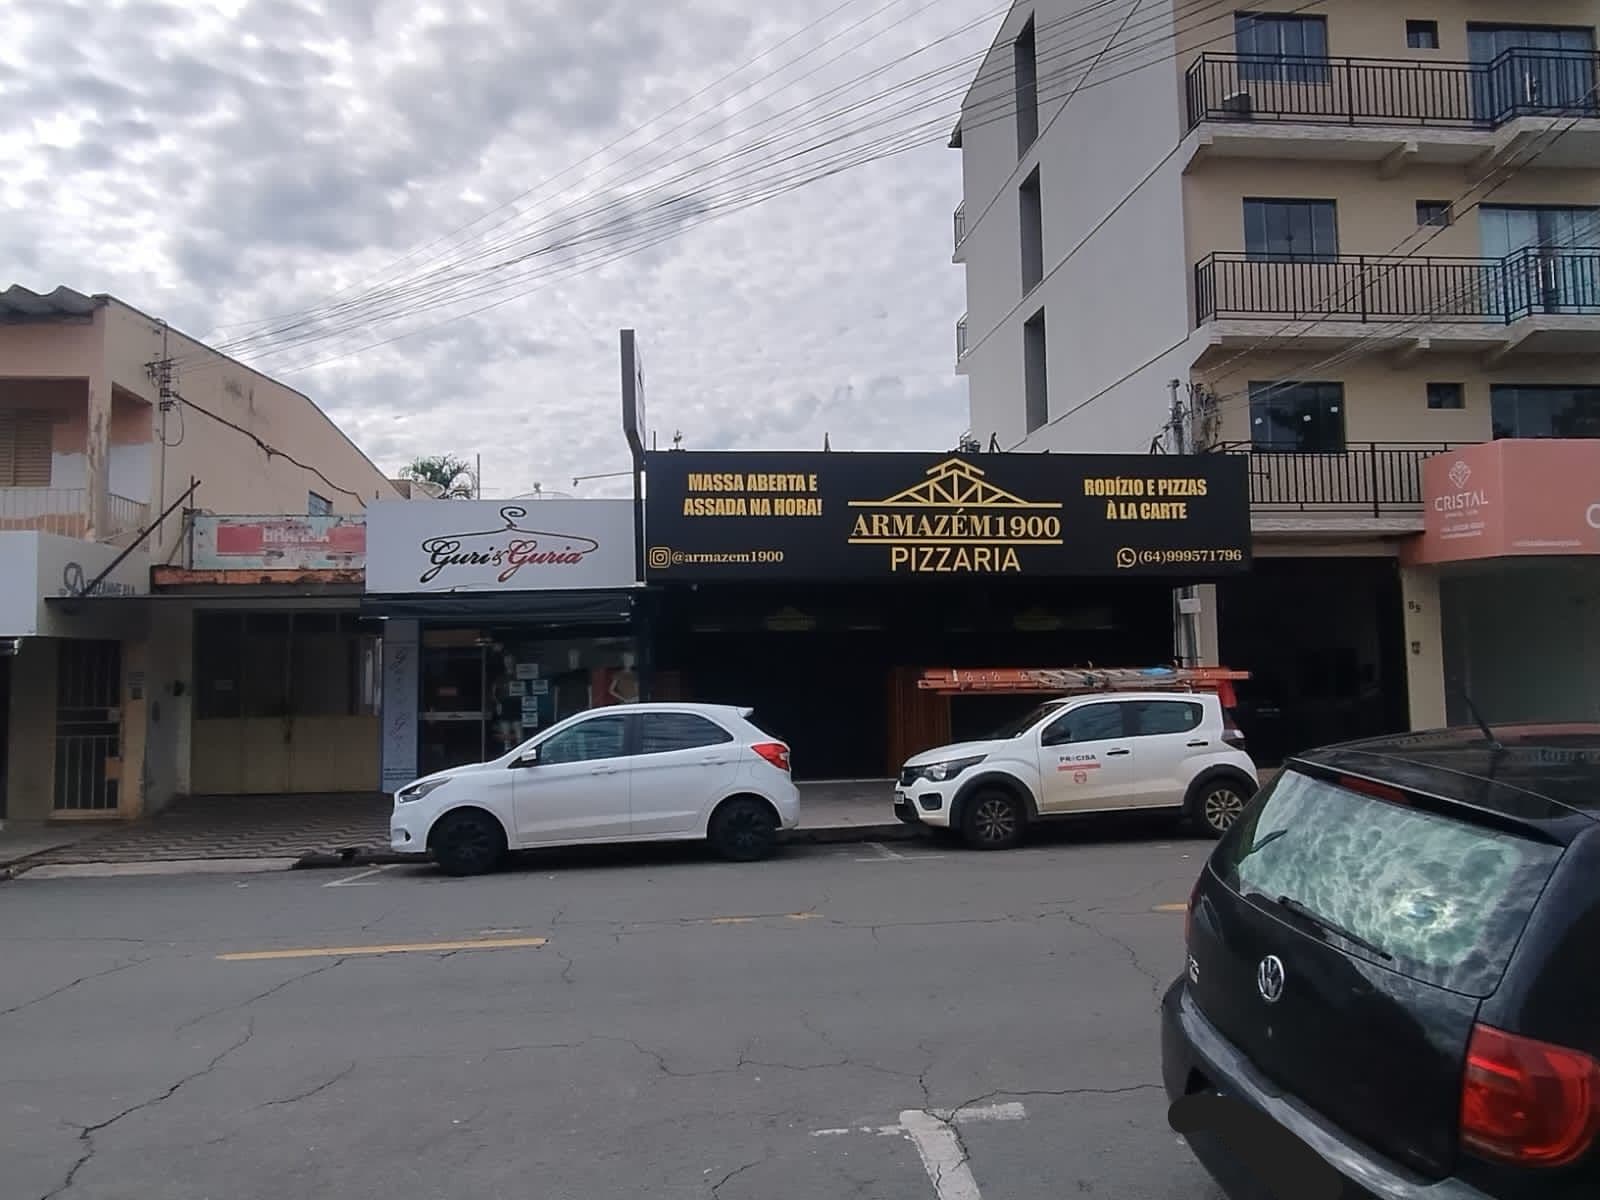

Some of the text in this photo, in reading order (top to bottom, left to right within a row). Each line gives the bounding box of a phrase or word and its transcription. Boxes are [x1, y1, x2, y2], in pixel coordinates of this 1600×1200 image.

[688, 474, 818, 492] MASSA ABERTA E
[1084, 476, 1207, 496] RODÍZIO E PIZZAS
[683, 498, 823, 516] ASSADA NA HORA!
[1106, 500, 1188, 519] À LA CARTE
[1434, 489, 1489, 512] CRISTAL
[671, 550, 784, 564] @armazem1900
[891, 547, 1021, 572] PIZZARIA
[1138, 549, 1242, 565] (64)999571796
